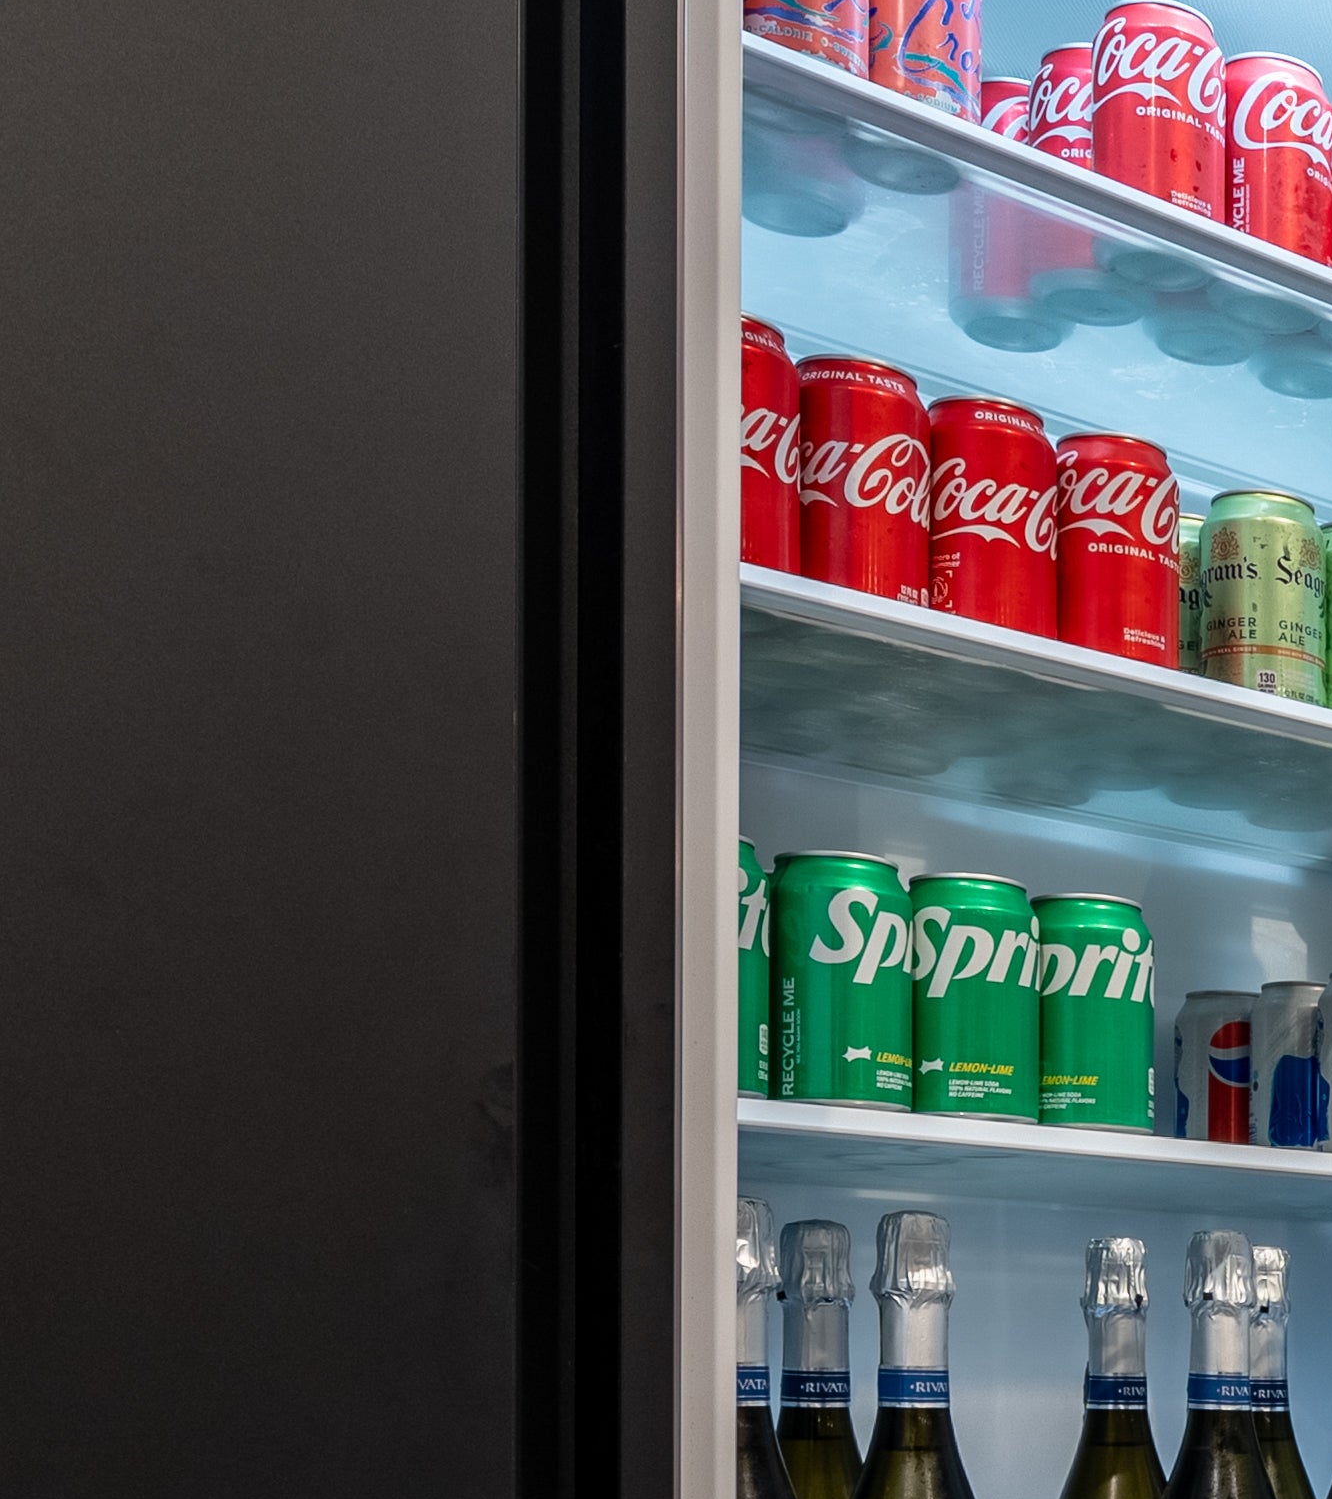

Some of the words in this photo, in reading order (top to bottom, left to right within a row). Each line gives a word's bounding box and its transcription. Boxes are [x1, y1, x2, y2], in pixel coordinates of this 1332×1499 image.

[1135, 105, 1201, 130] ORIGINAL
[801, 369, 863, 382] ORIGINAL
[866, 373, 906, 394] TASTE
[974, 409, 1035, 432] ORIGINAL
[1087, 541, 1155, 562] ORIGINAL
[1123, 626, 1160, 641] Delicious
[1206, 616, 1257, 631] GINGER
[1278, 619, 1323, 641] GINGER
[1228, 629, 1257, 641] ALE
[1278, 632, 1306, 647] ALE
[1258, 672, 1276, 684] 130
[783, 976, 795, 1006] ME
[782, 1010, 795, 1096] RECYCLE
[948, 1061, 1014, 1076] LEMON-LIME
